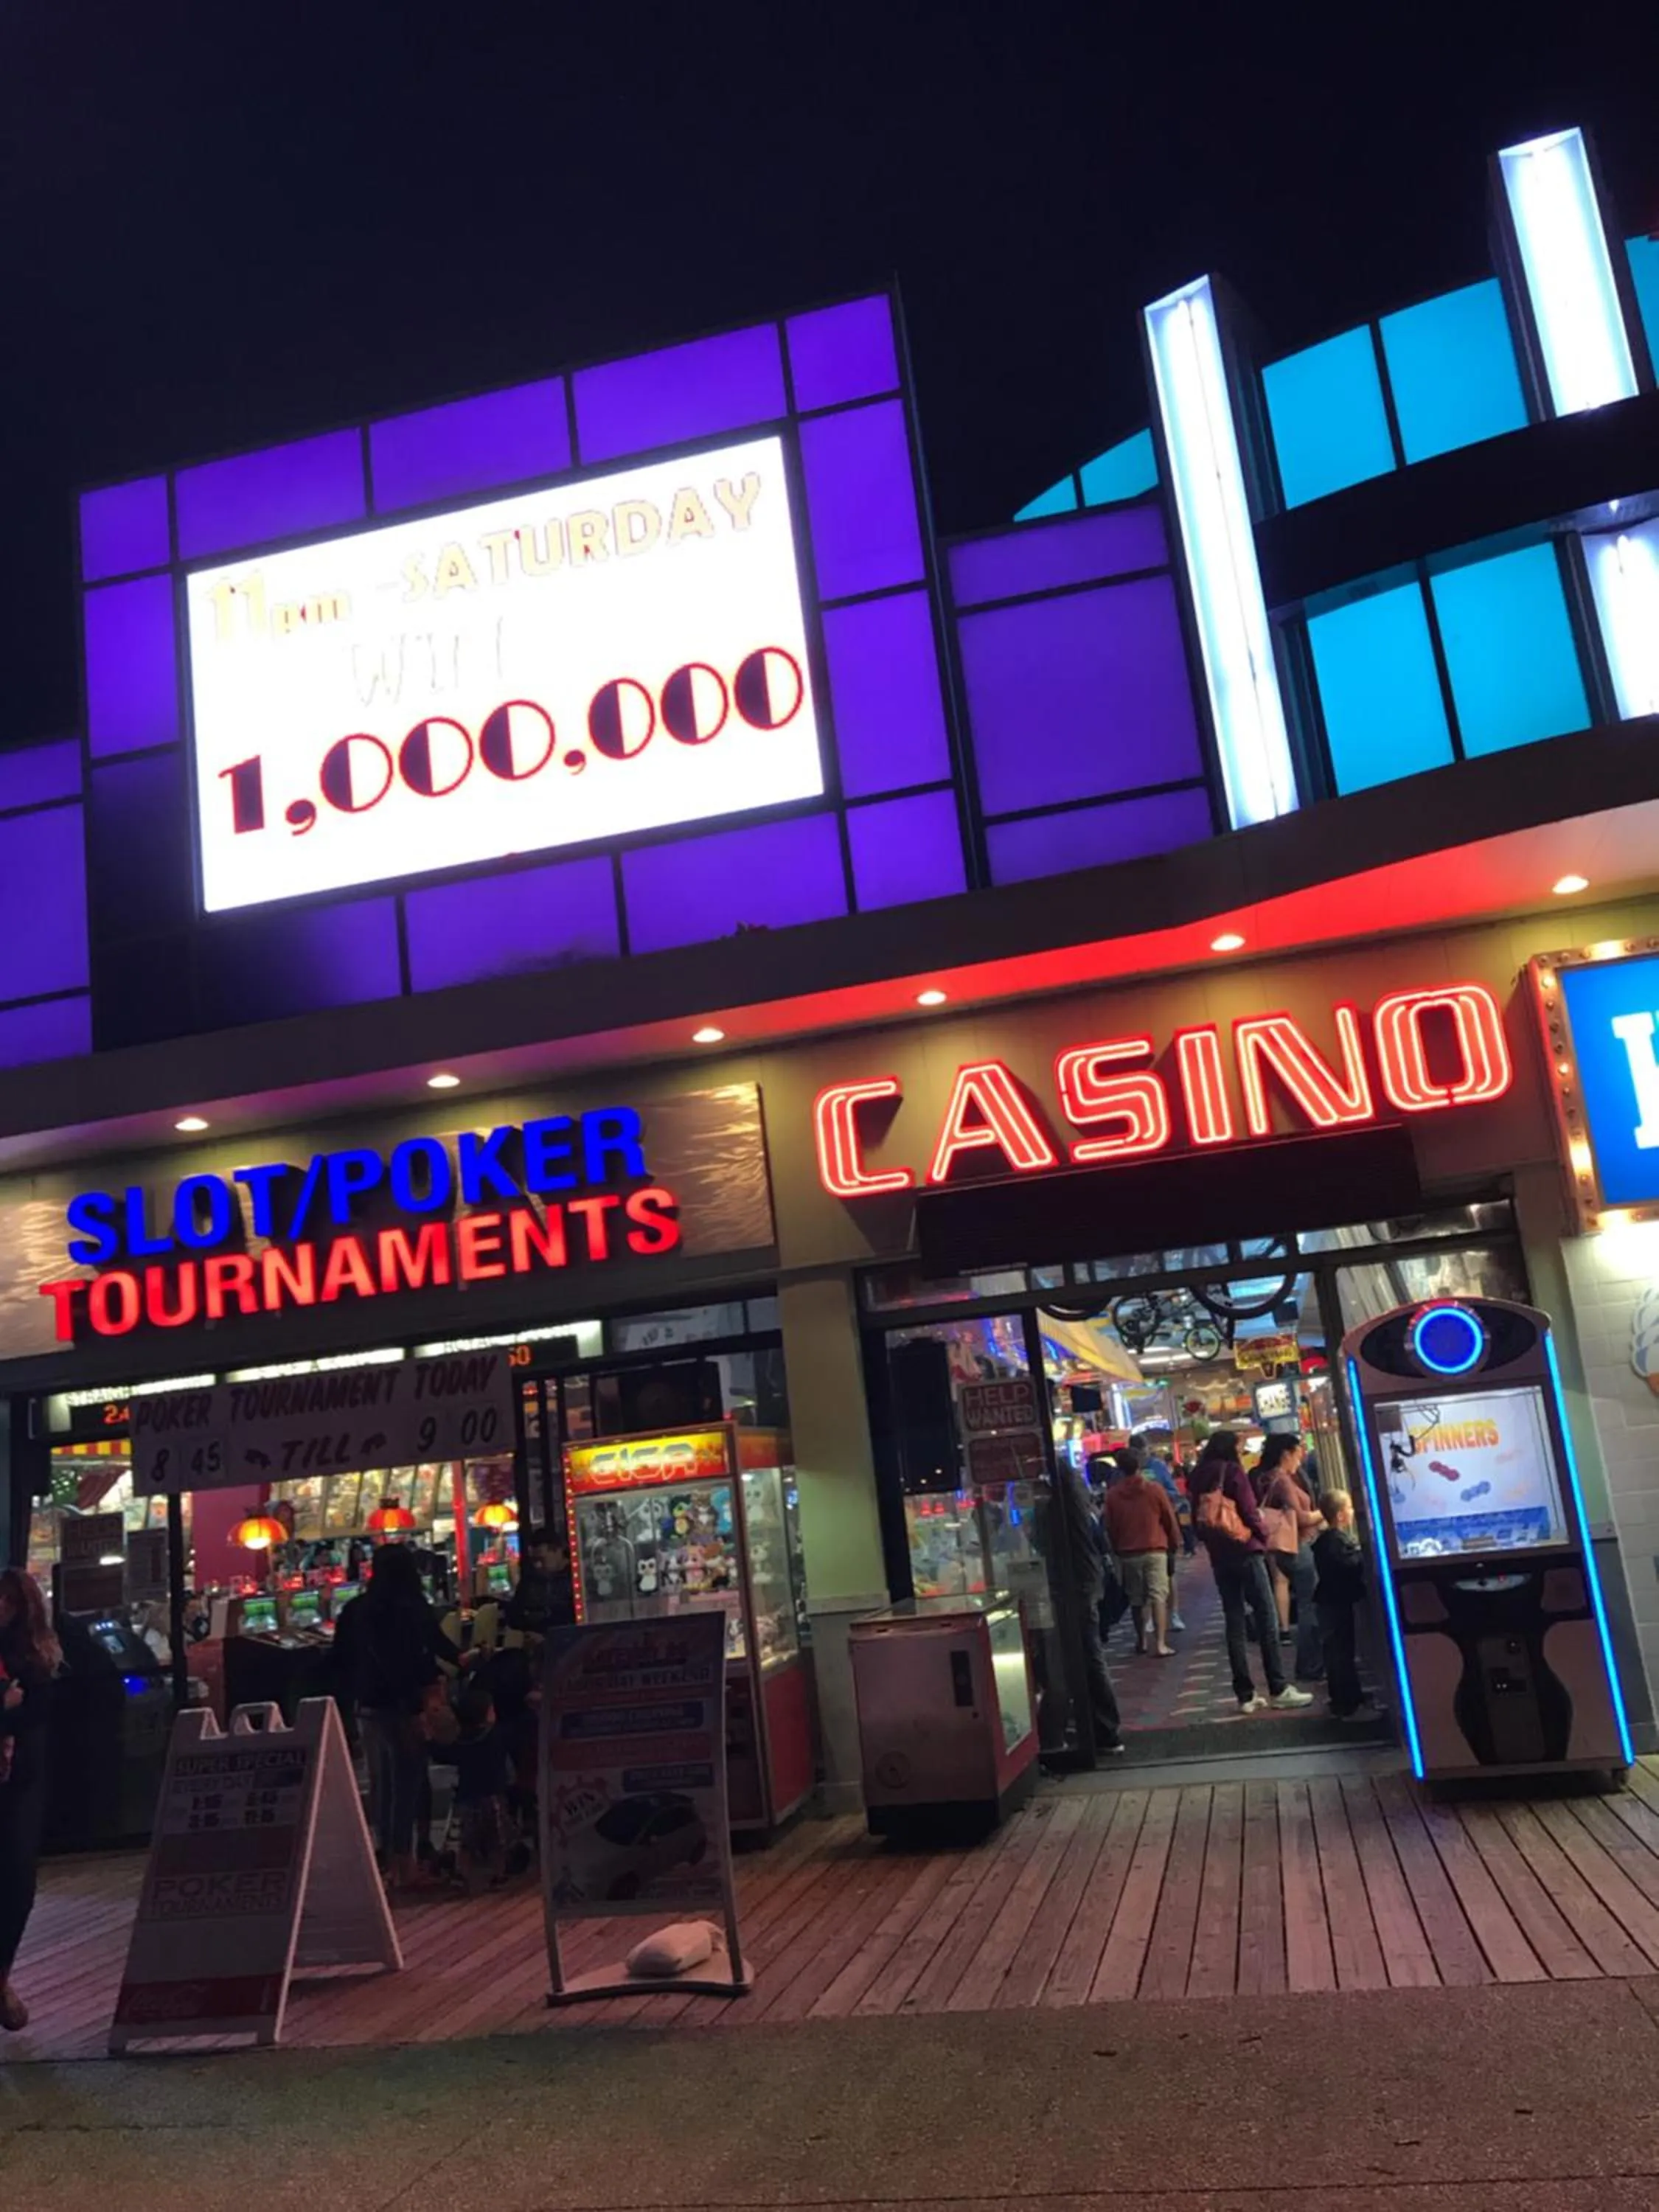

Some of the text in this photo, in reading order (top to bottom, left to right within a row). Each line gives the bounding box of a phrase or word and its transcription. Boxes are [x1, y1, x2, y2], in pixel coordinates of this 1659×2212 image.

[218, 646, 805, 836] 1,000,000
[813, 981, 1513, 1198] CASINO
[66, 1107, 647, 1265] SLOT/POKER
[38, 1188, 681, 1342] TOURNAMENTS
[135, 1392, 212, 1435] POKER
[229, 1367, 402, 1423] TOURNAMENT
[414, 1354, 498, 1400] TODAY
[964, 1383, 1031, 1407] HELP
[966, 1405, 1034, 1428] WANTED
[279, 1433, 352, 1472] TILL
[153, 1871, 287, 1899] POKER
